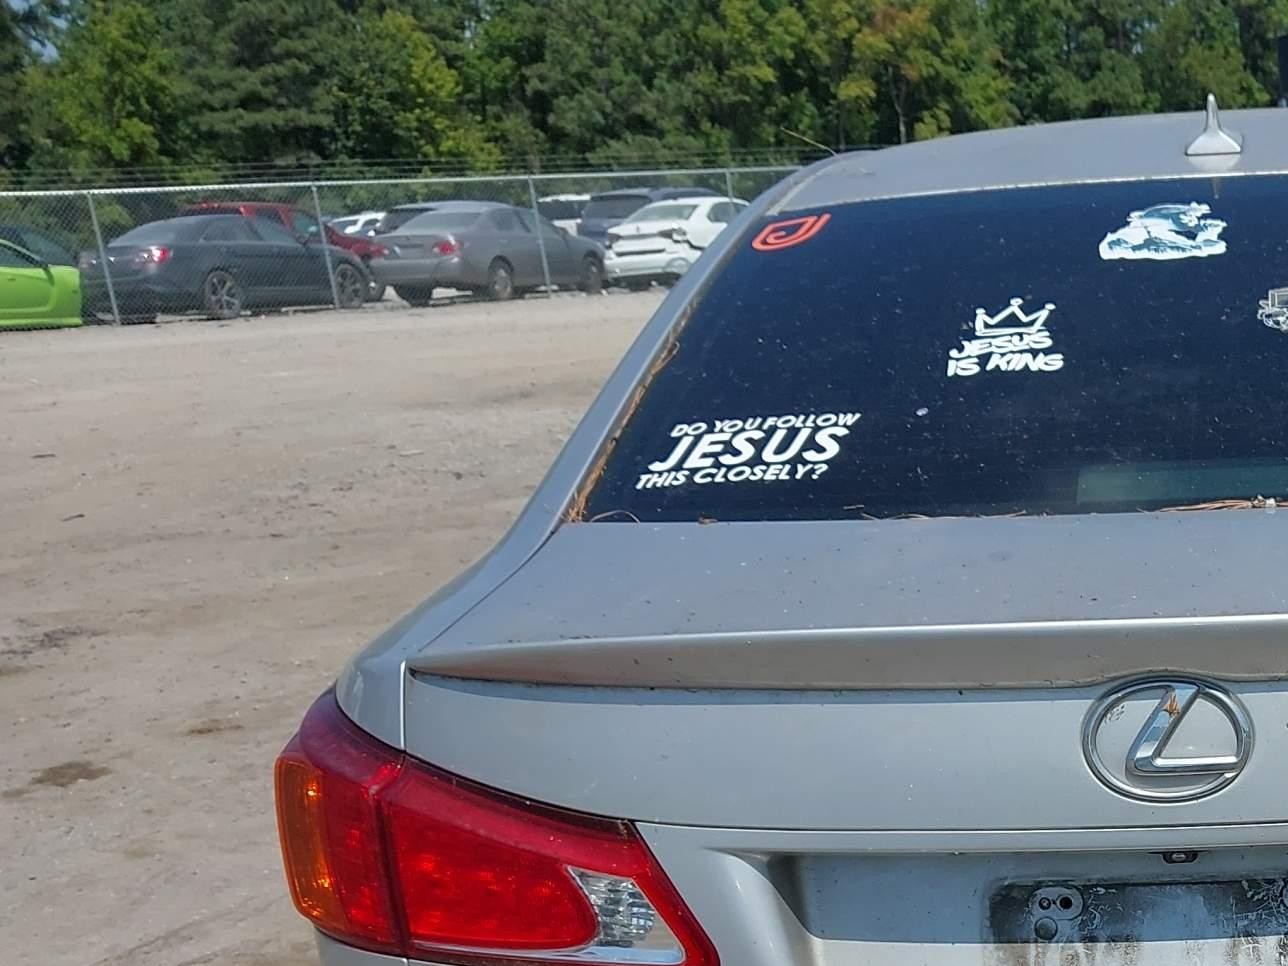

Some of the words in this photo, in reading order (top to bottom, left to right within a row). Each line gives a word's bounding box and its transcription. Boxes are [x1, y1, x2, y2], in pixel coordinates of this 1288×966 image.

[948, 331, 1053, 358] JESUS
[946, 357, 981, 377] IS
[985, 352, 1064, 371] KING
[670, 421, 708, 437] DO
[713, 417, 763, 433] YOU
[763, 412, 861, 428] FOLLOW
[648, 426, 849, 472] JESUS
[635, 469, 689, 490] THIS
[693, 463, 828, 484] CLOSELY?
